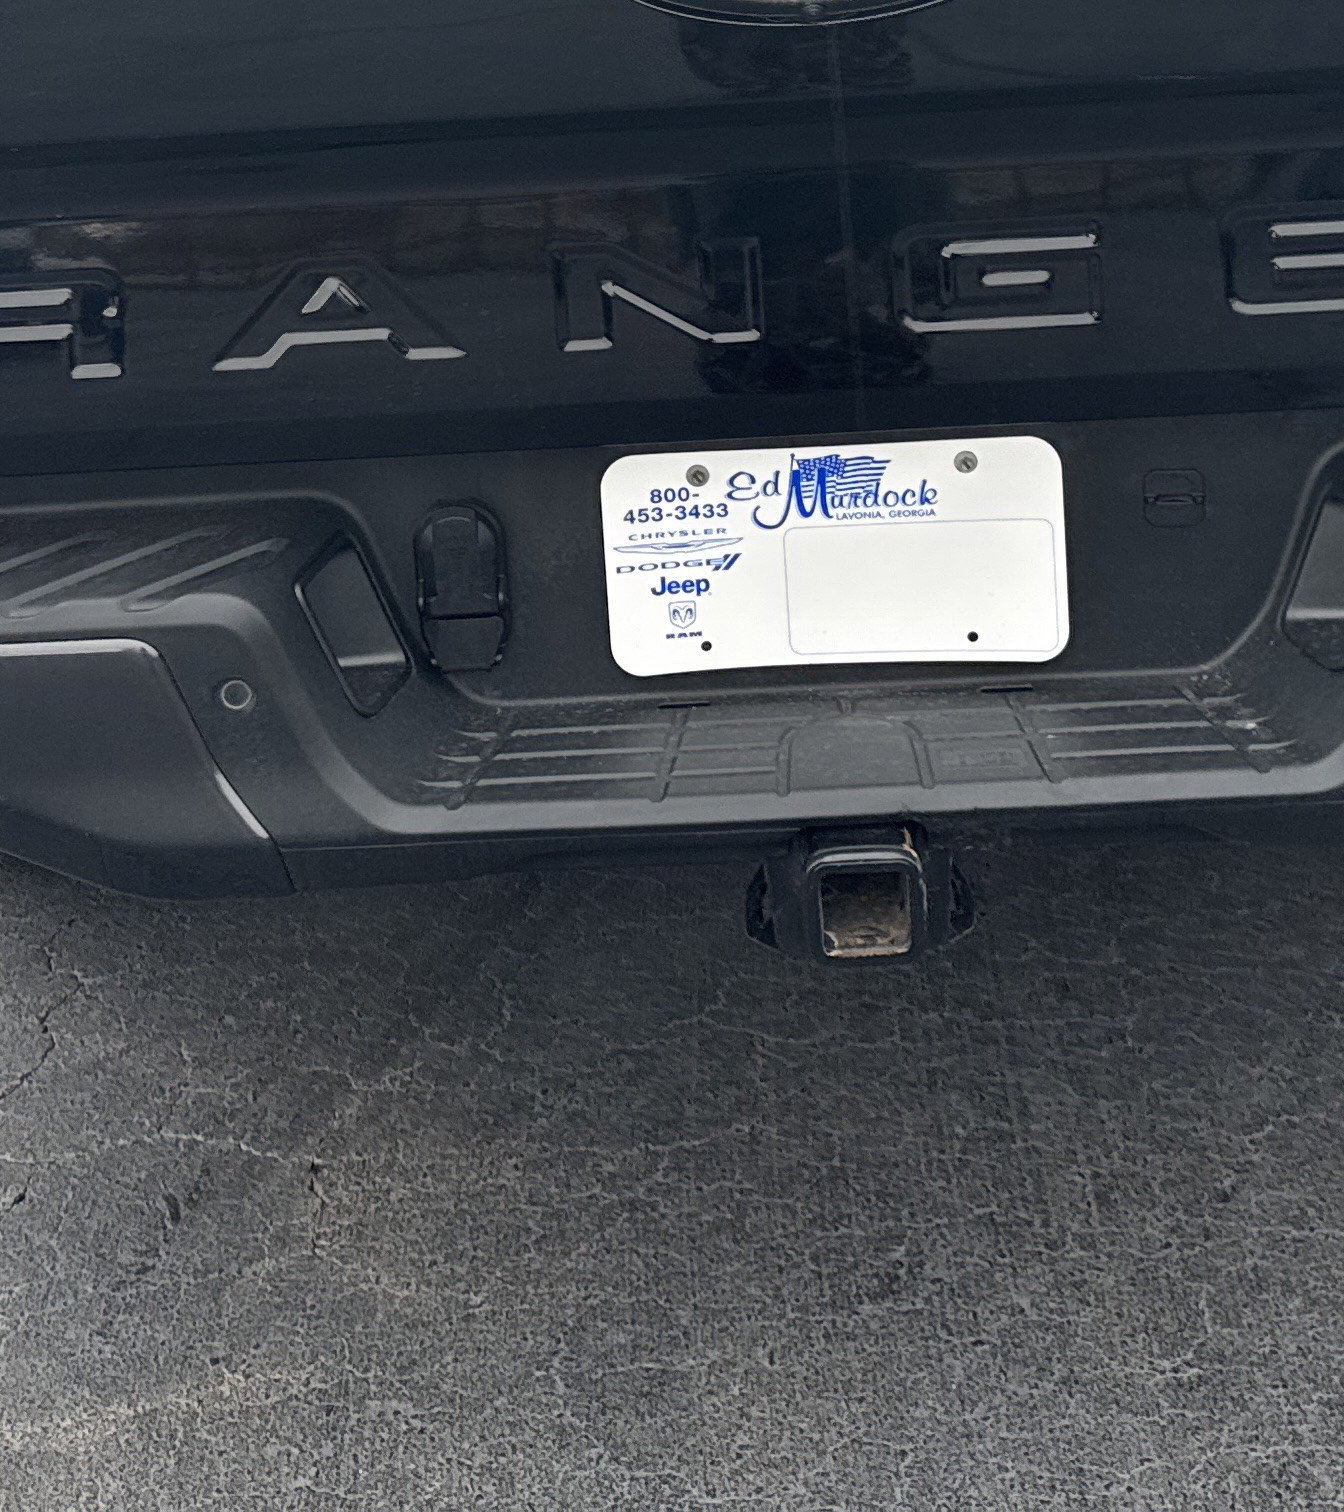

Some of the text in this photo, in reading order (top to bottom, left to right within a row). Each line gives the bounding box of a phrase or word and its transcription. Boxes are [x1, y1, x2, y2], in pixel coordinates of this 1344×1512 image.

[649, 486, 700, 504] 800-
[724, 466, 939, 530] Ed Murdock
[623, 502, 729, 525] 453-3433
[835, 507, 937, 521] LAVONIA, GEORGIA
[628, 527, 728, 541] CHRYSLER
[616, 557, 725, 574] DODGE
[650, 575, 710, 597] Jeep
[665, 630, 703, 640] RAM
